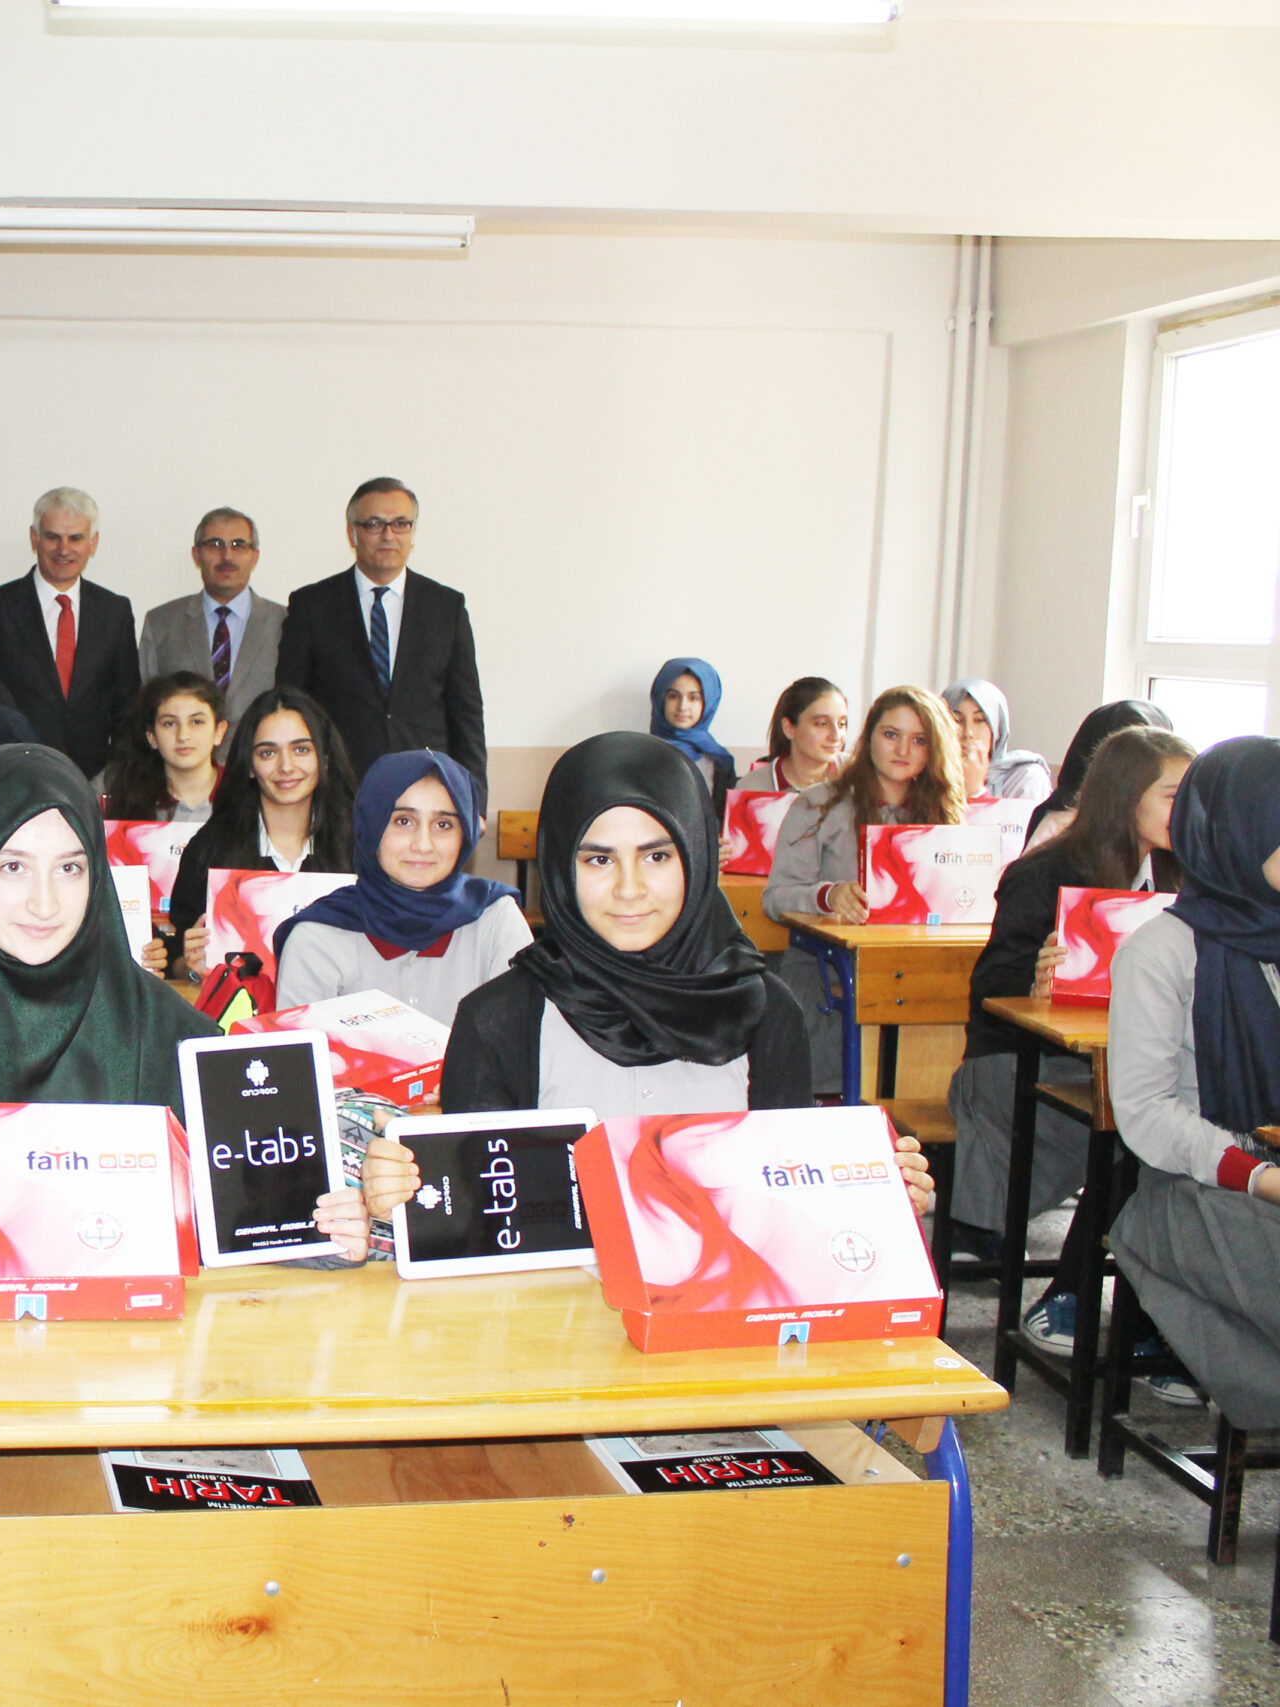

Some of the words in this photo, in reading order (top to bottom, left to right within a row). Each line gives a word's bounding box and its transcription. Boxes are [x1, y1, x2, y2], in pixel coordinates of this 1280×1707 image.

[571, 1183, 583, 1230] GENERAL
[234, 1225, 279, 1236] GENERAL
[32, 1282, 79, 1291] MOBILE
[745, 1312, 798, 1322] GENERAL
[800, 1309, 846, 1319] MOBILE
[656, 1457, 805, 1485] TARİH
